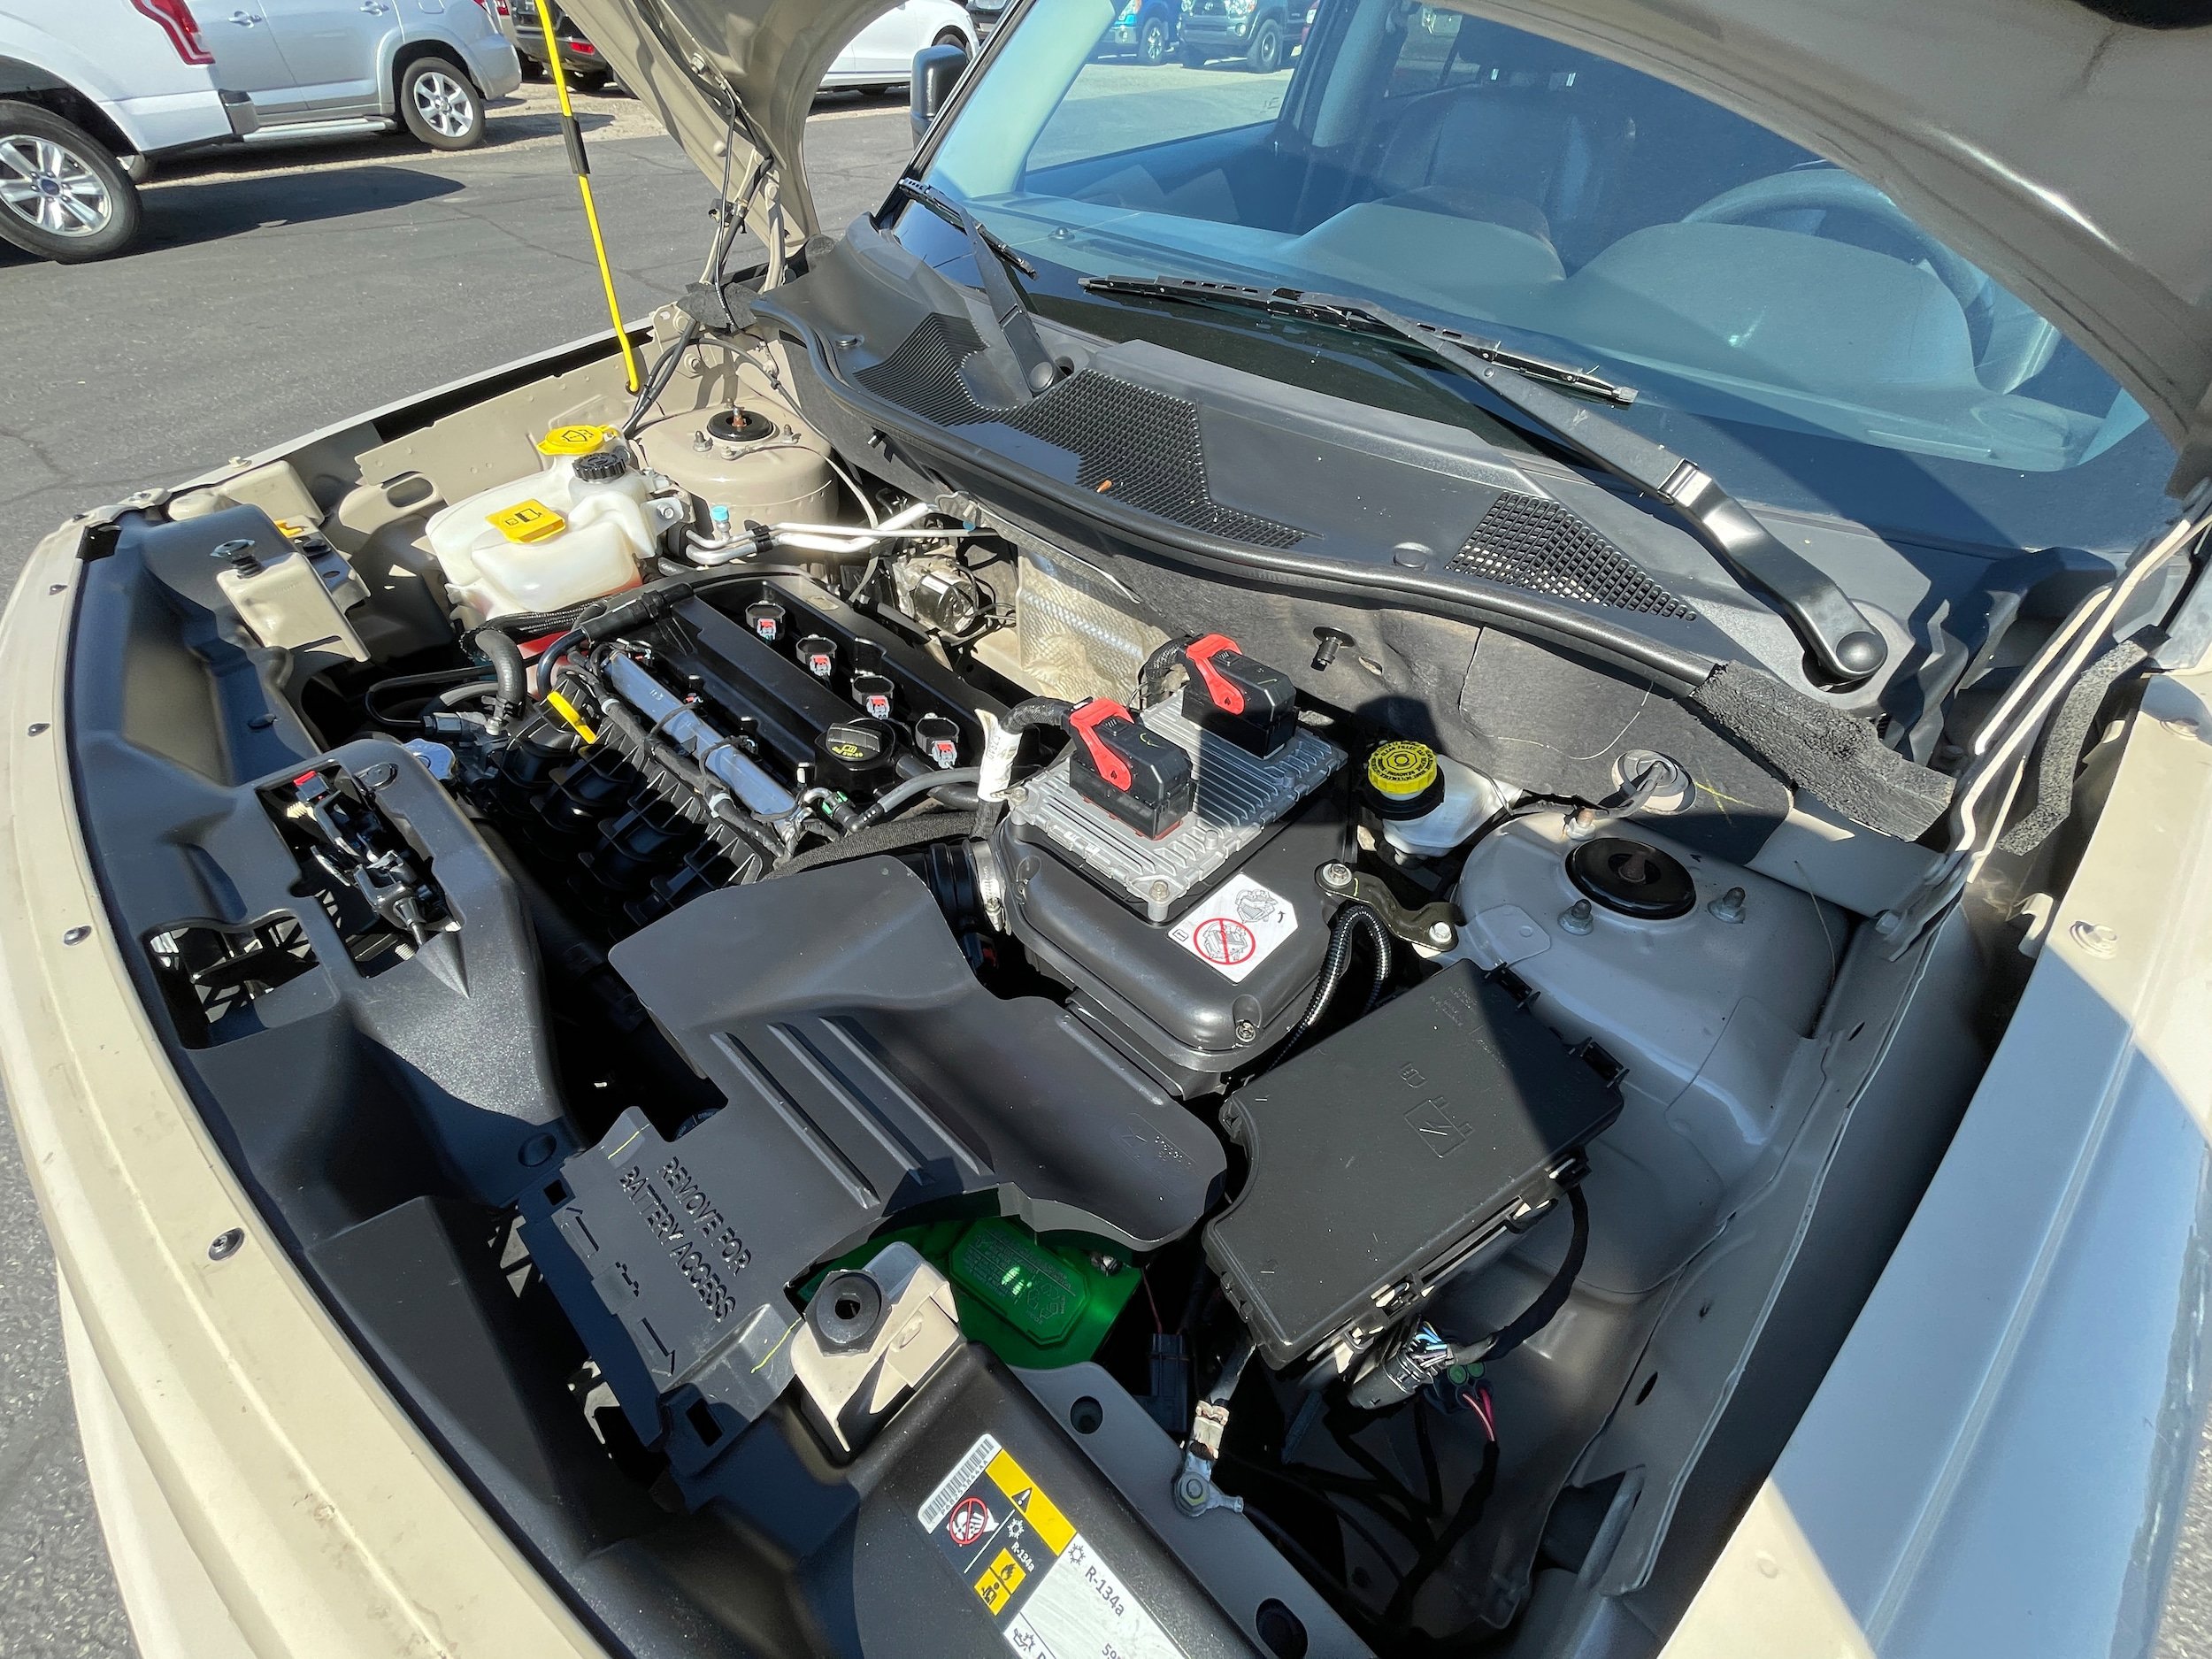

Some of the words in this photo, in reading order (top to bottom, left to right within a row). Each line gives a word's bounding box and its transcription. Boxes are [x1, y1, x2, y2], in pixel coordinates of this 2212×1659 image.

[619, 1165, 685, 1246] BATTERY
[670, 1241, 736, 1323] ACCESS
[657, 1156, 725, 1238] REMOVE
[710, 1227, 751, 1277] FOR
[1010, 1540, 1035, 1573] R-134a
[1085, 1565, 1125, 1617] R-134a
